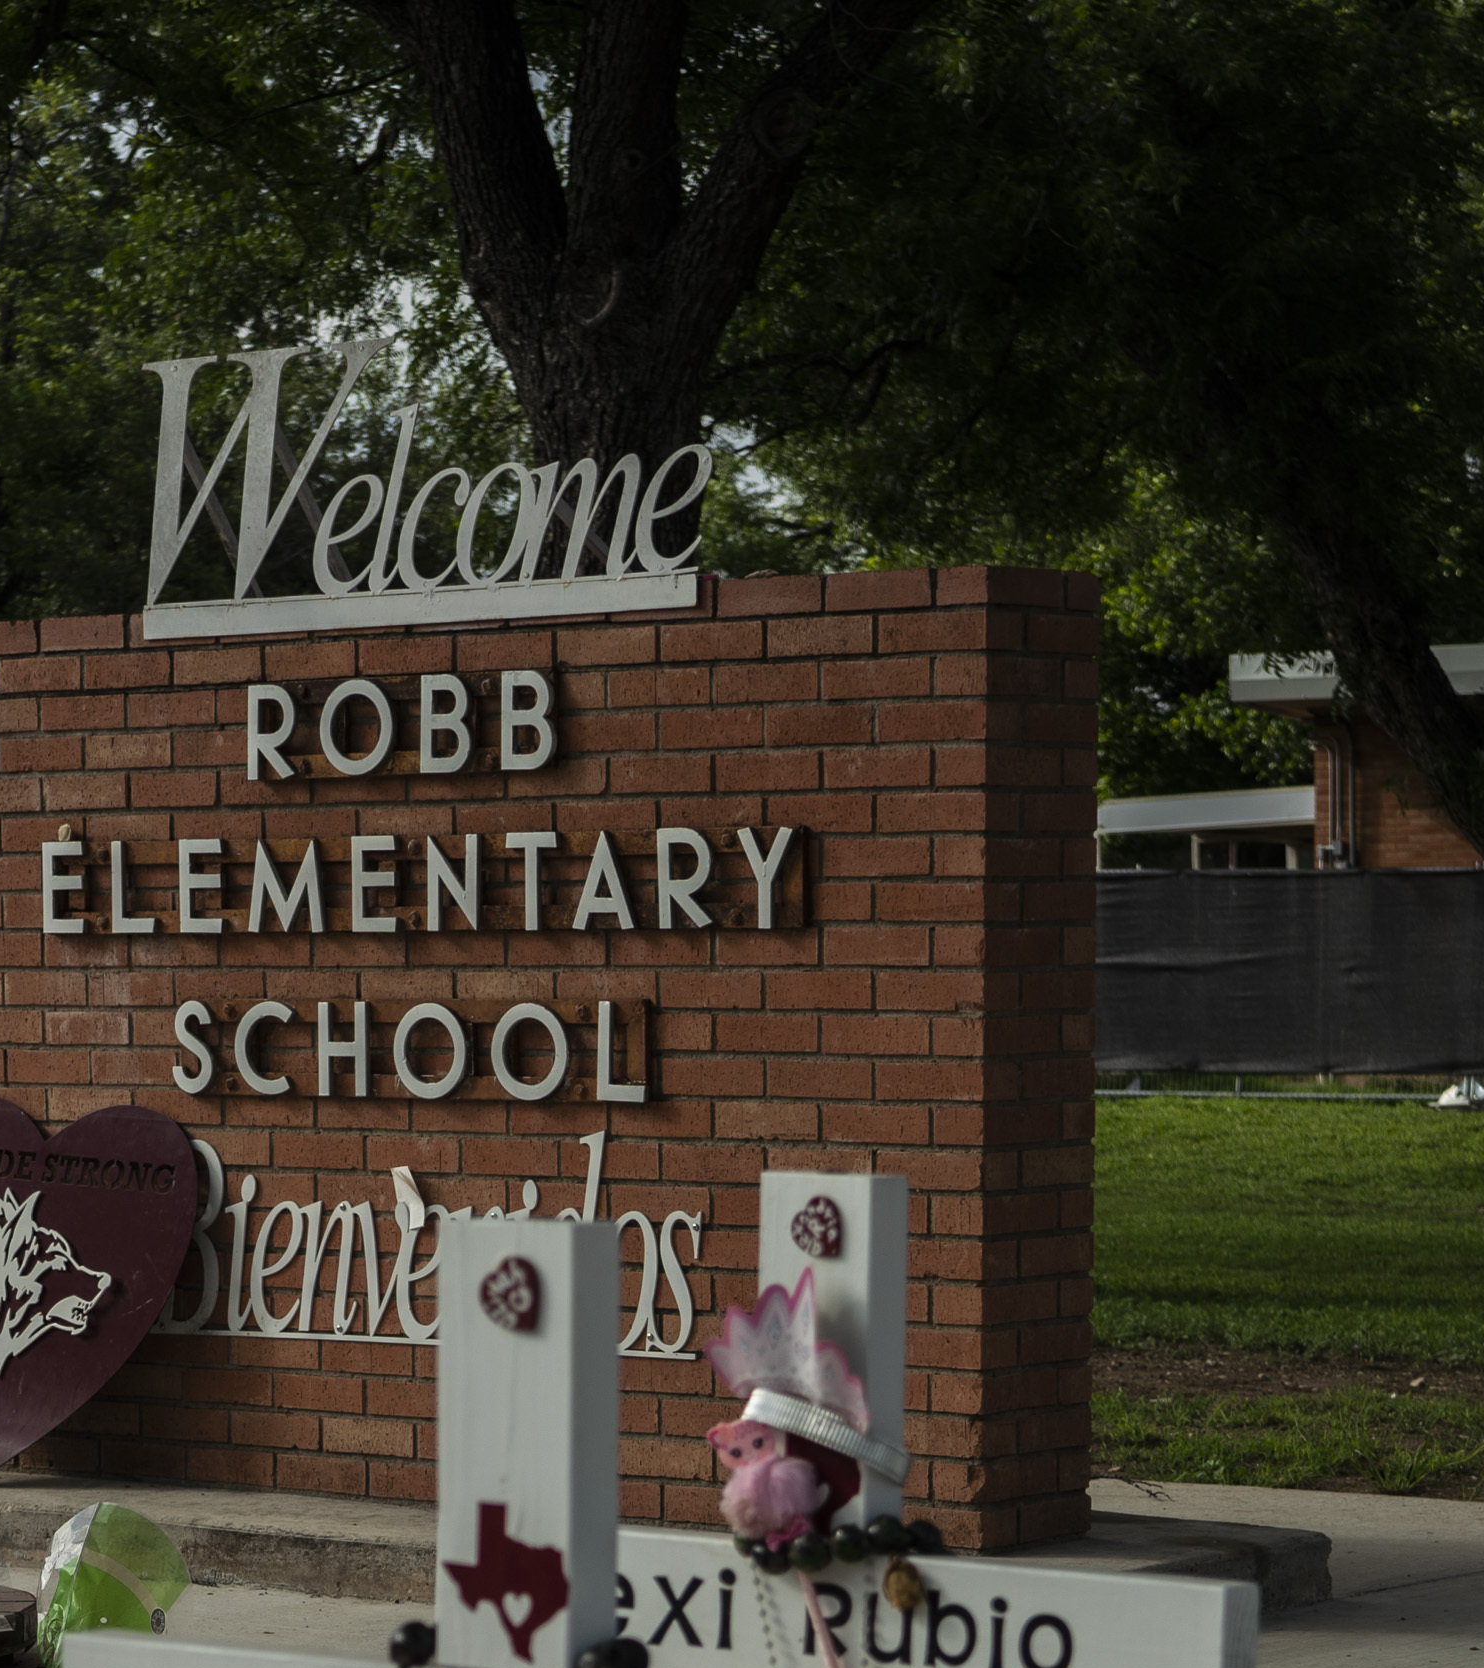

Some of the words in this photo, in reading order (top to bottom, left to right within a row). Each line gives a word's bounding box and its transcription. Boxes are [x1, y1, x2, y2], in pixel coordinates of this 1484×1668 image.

[142, 336, 713, 604] Welcome
[247, 670, 556, 781] ROBB
[41, 826, 794, 934] ELEMENTARY
[173, 1000, 650, 1103] SCHOOL
[41, 1153, 176, 1194] STRONG
[156, 1130, 703, 1353] Bienveos
